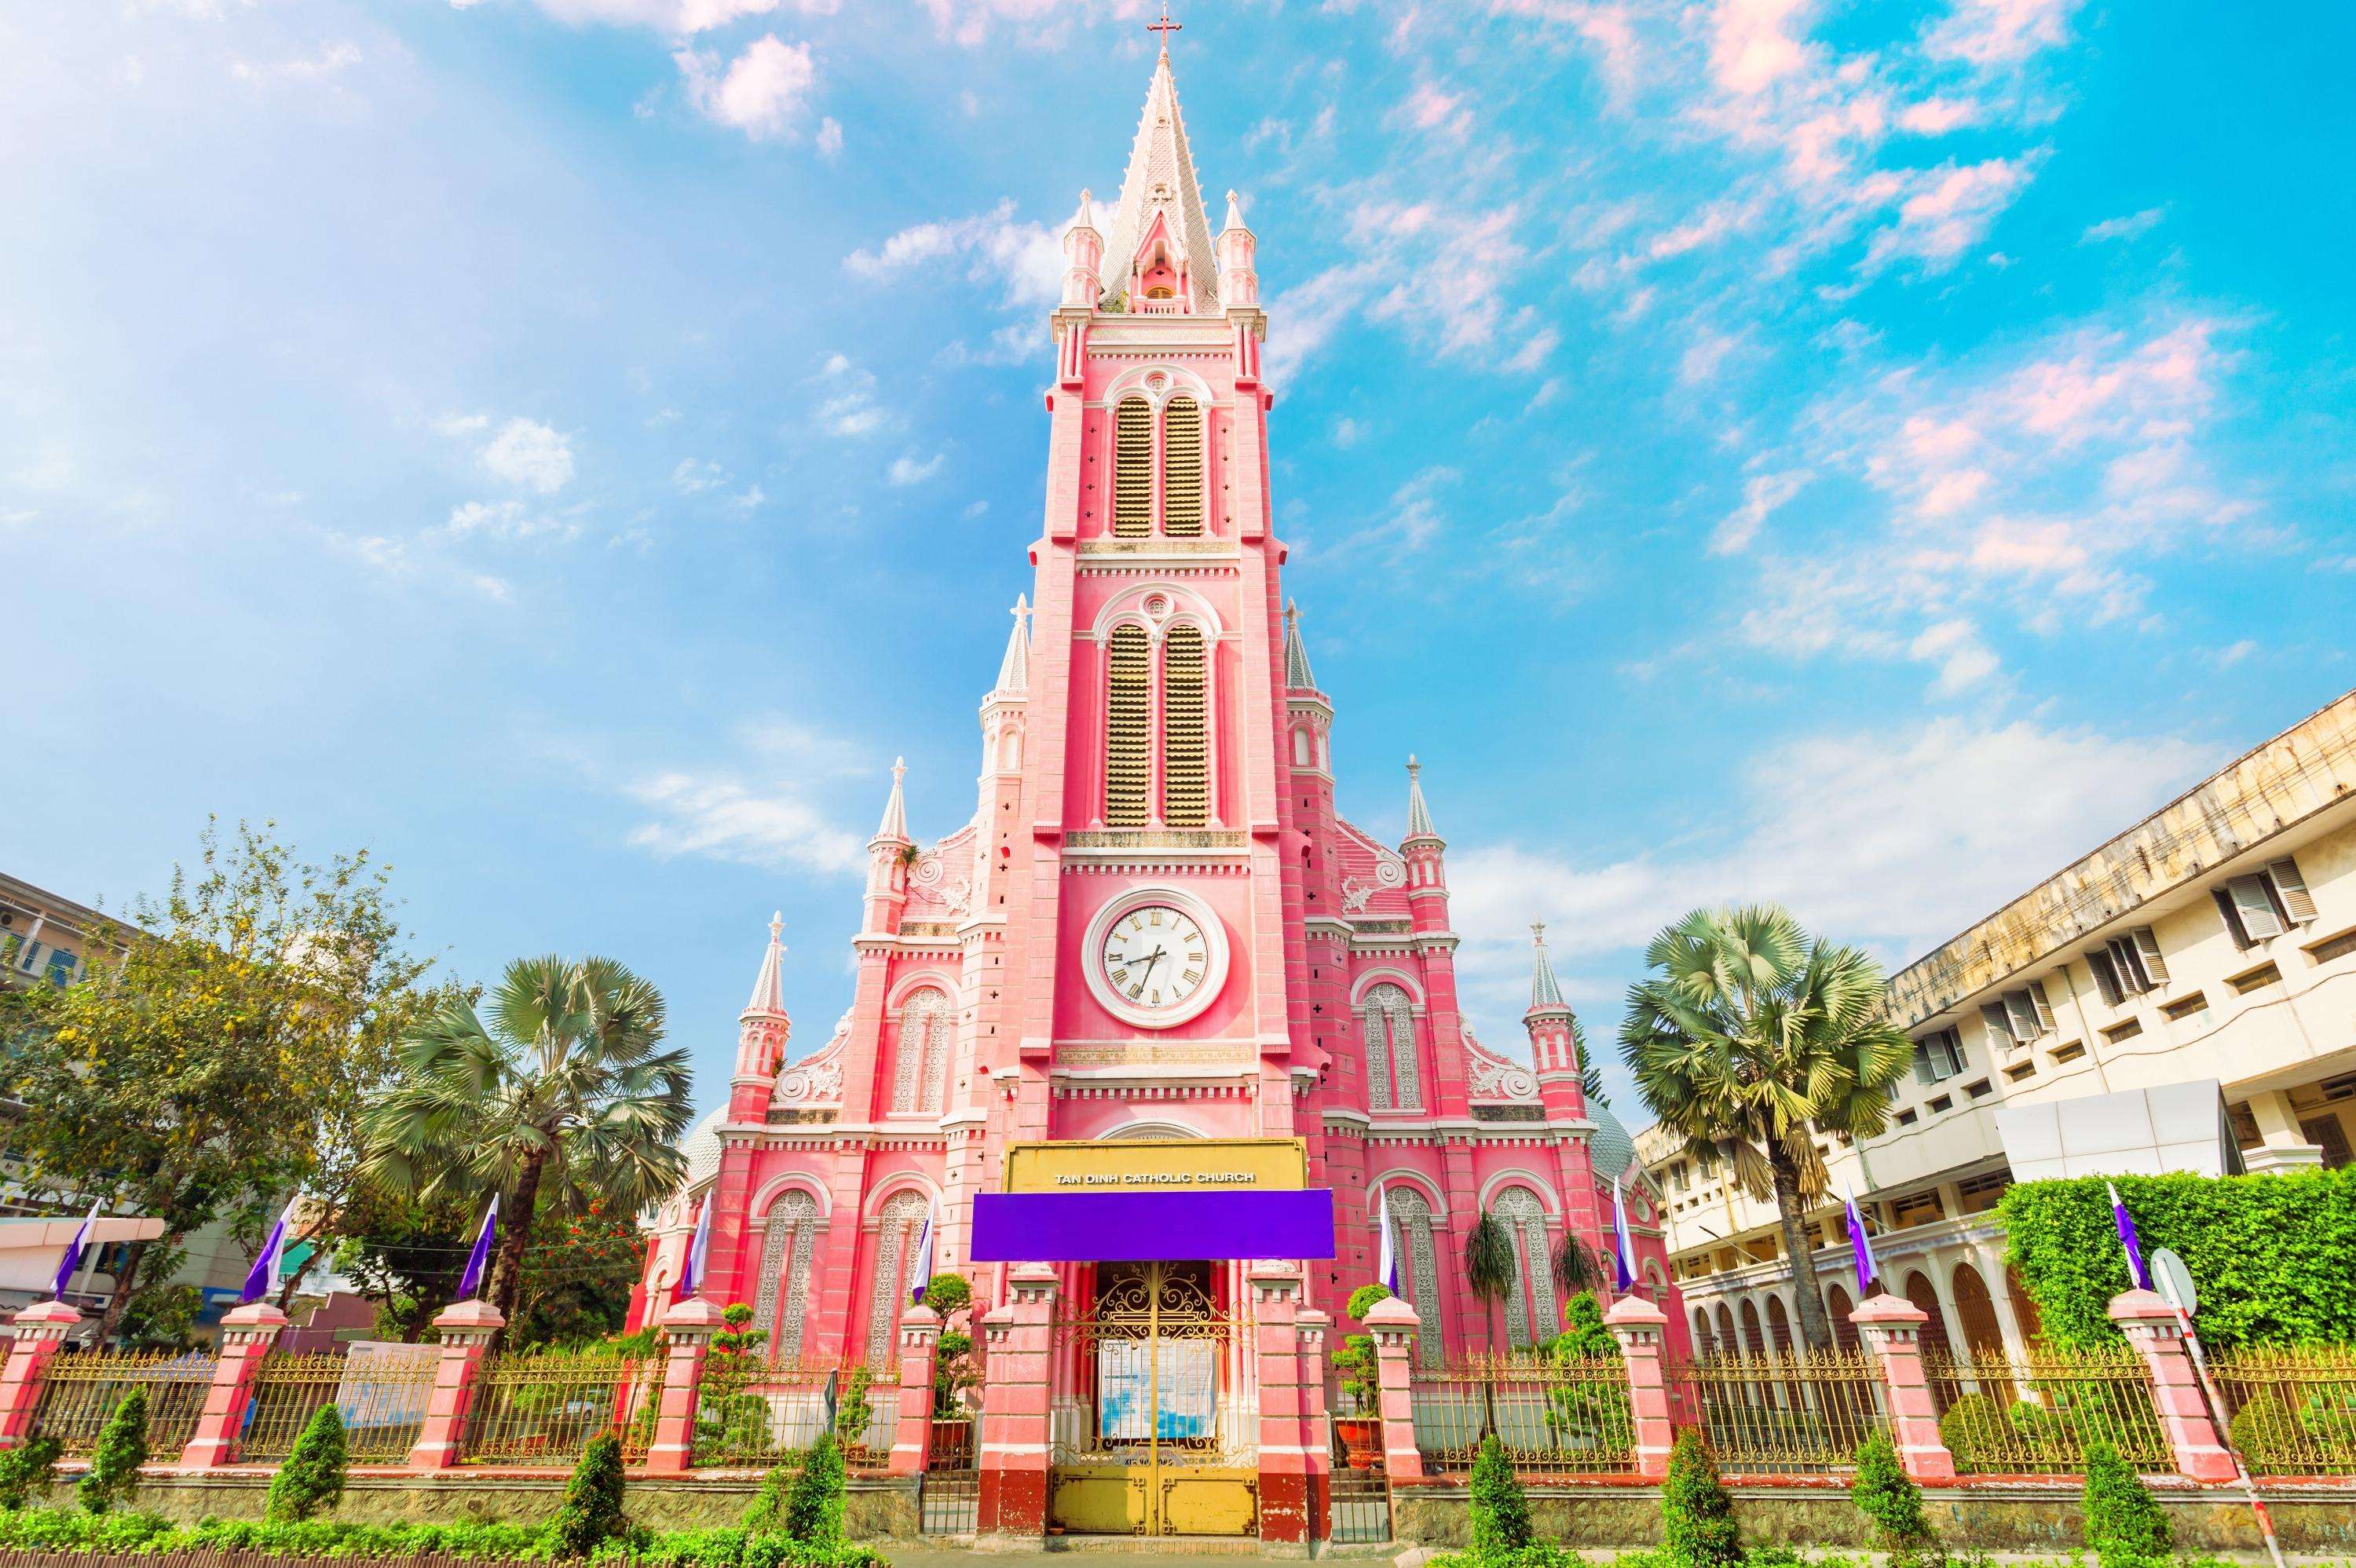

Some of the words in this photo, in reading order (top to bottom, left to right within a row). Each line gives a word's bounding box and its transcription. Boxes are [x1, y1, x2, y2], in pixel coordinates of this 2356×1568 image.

[1183, 933, 1198, 942] II
[1108, 953, 1122, 962] IX
[1188, 952, 1202, 961] III
[1055, 1174, 1081, 1184] TAN
[1086, 1174, 1119, 1184] DINH
[1124, 1172, 1192, 1183] CATHOLIC
[1196, 1171, 1255, 1182] CHURCH
